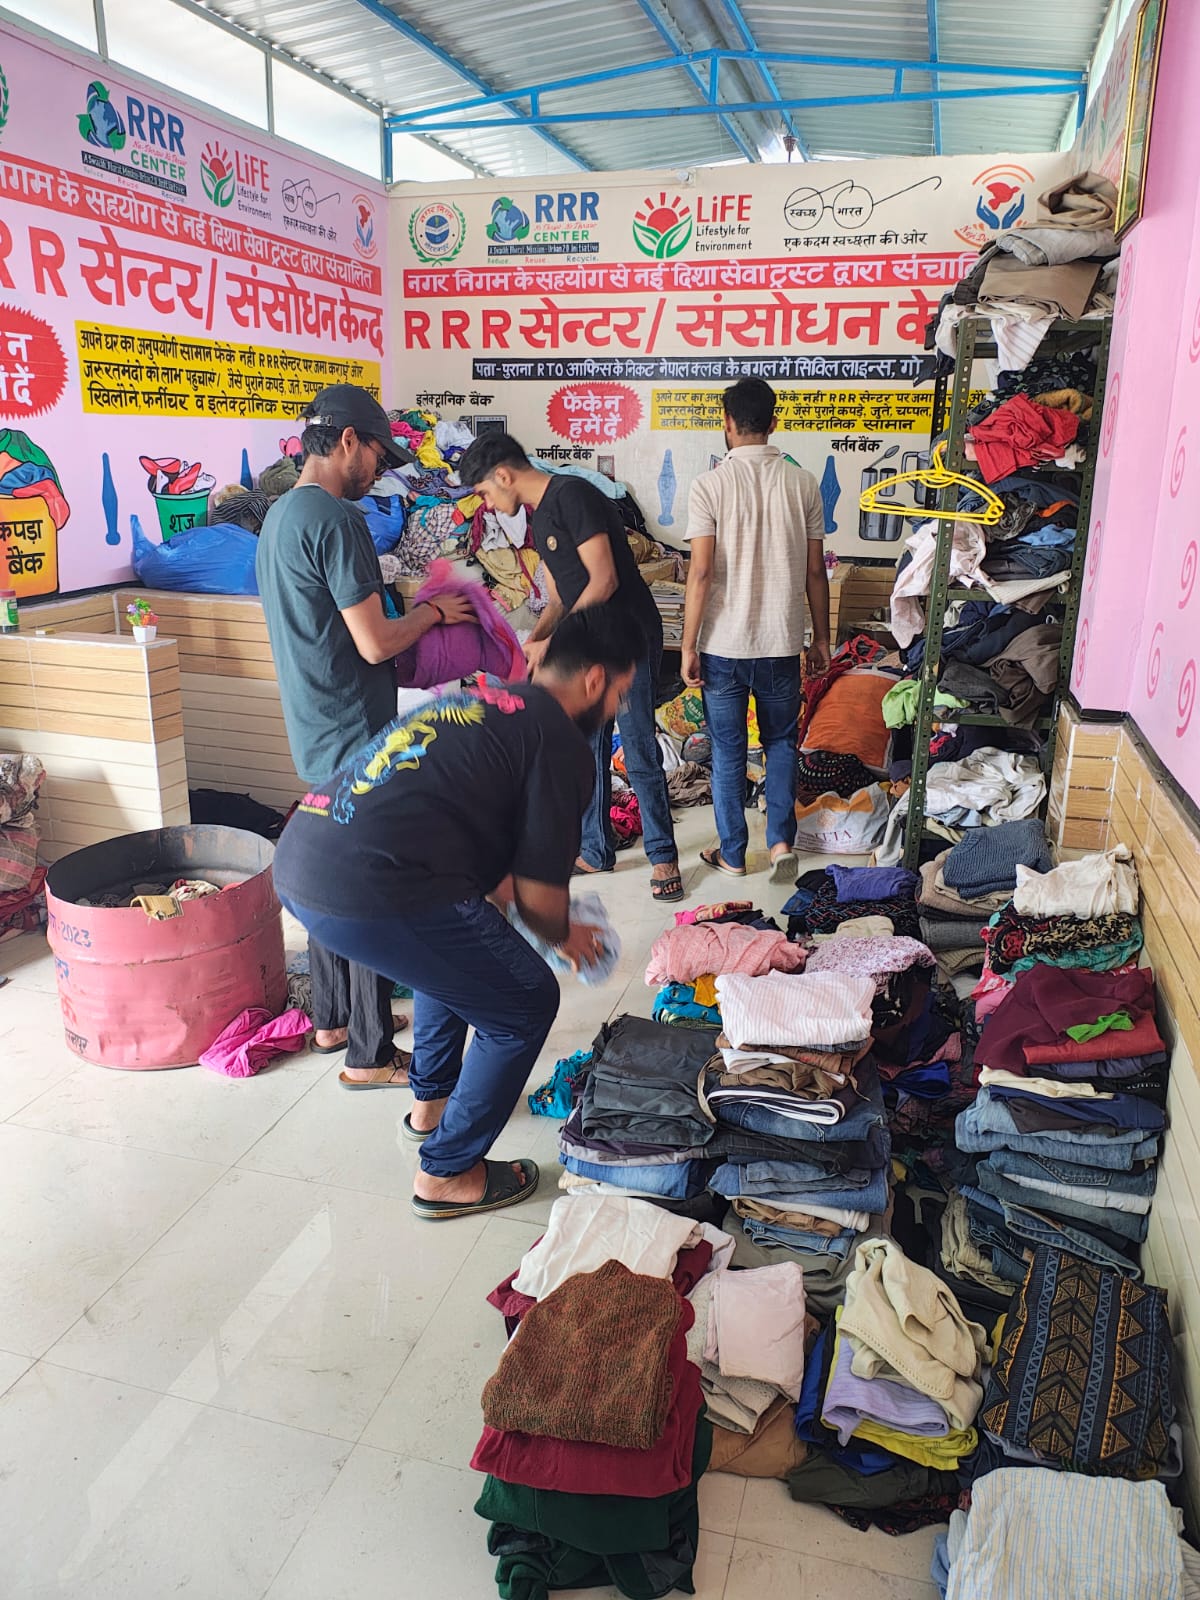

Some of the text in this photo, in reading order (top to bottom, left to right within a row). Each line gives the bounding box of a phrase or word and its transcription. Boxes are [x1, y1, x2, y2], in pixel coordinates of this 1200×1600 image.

[127, 96, 185, 156] RRR
[131, 150, 186, 181] CENTER
[235, 150, 270, 192] LiFE
[237, 185, 268, 204] Lifestyle for
[535, 192, 599, 223] RRR
[238, 202, 272, 221] Environment
[697, 195, 752, 222] LiFE
[57, 169, 80, 207] के
[83, 181, 158, 230] सहयोग
[159, 202, 180, 235] से
[182, 212, 207, 245] नई
[209, 217, 240, 252] दिशा
[243, 226, 269, 259] सेवा
[325, 253, 373, 289] संचालित
[534, 230, 590, 243] CENTER
[696, 224, 750, 238] Lifestyle for
[880, 230, 899, 245] की
[901, 229, 928, 245] ओर
[696, 240, 752, 252] Environment
[408, 275, 450, 293] नगर
[452, 269, 511, 293] निगम
[512, 266, 536, 290] के
[536, 265, 608, 292] सहयोग
[609, 264, 630, 289] से
[634, 263, 668, 291] नई
[671, 263, 719, 288] दिशा
[720, 260, 768, 286] सेवा
[769, 262, 829, 288] ट्रस्ट
[832, 260, 886, 285] द्वारा
[226, 265, 337, 341] संसोधन
[676, 292, 890, 348] संसोधन
[80, 327, 102, 350] अपने
[104, 334, 120, 354] घर
[120, 335, 135, 353] का
[180, 343, 213, 362] सामान
[145, 361, 159, 382] को
[624, 359, 656, 377] निकट
[659, 358, 690, 377] नेपाल
[691, 360, 722, 377] क्लब
[779, 356, 794, 377] में
[794, 356, 842, 378] सिविल
[568, 414, 602, 439] हमें
[862, 419, 915, 431] सामान
